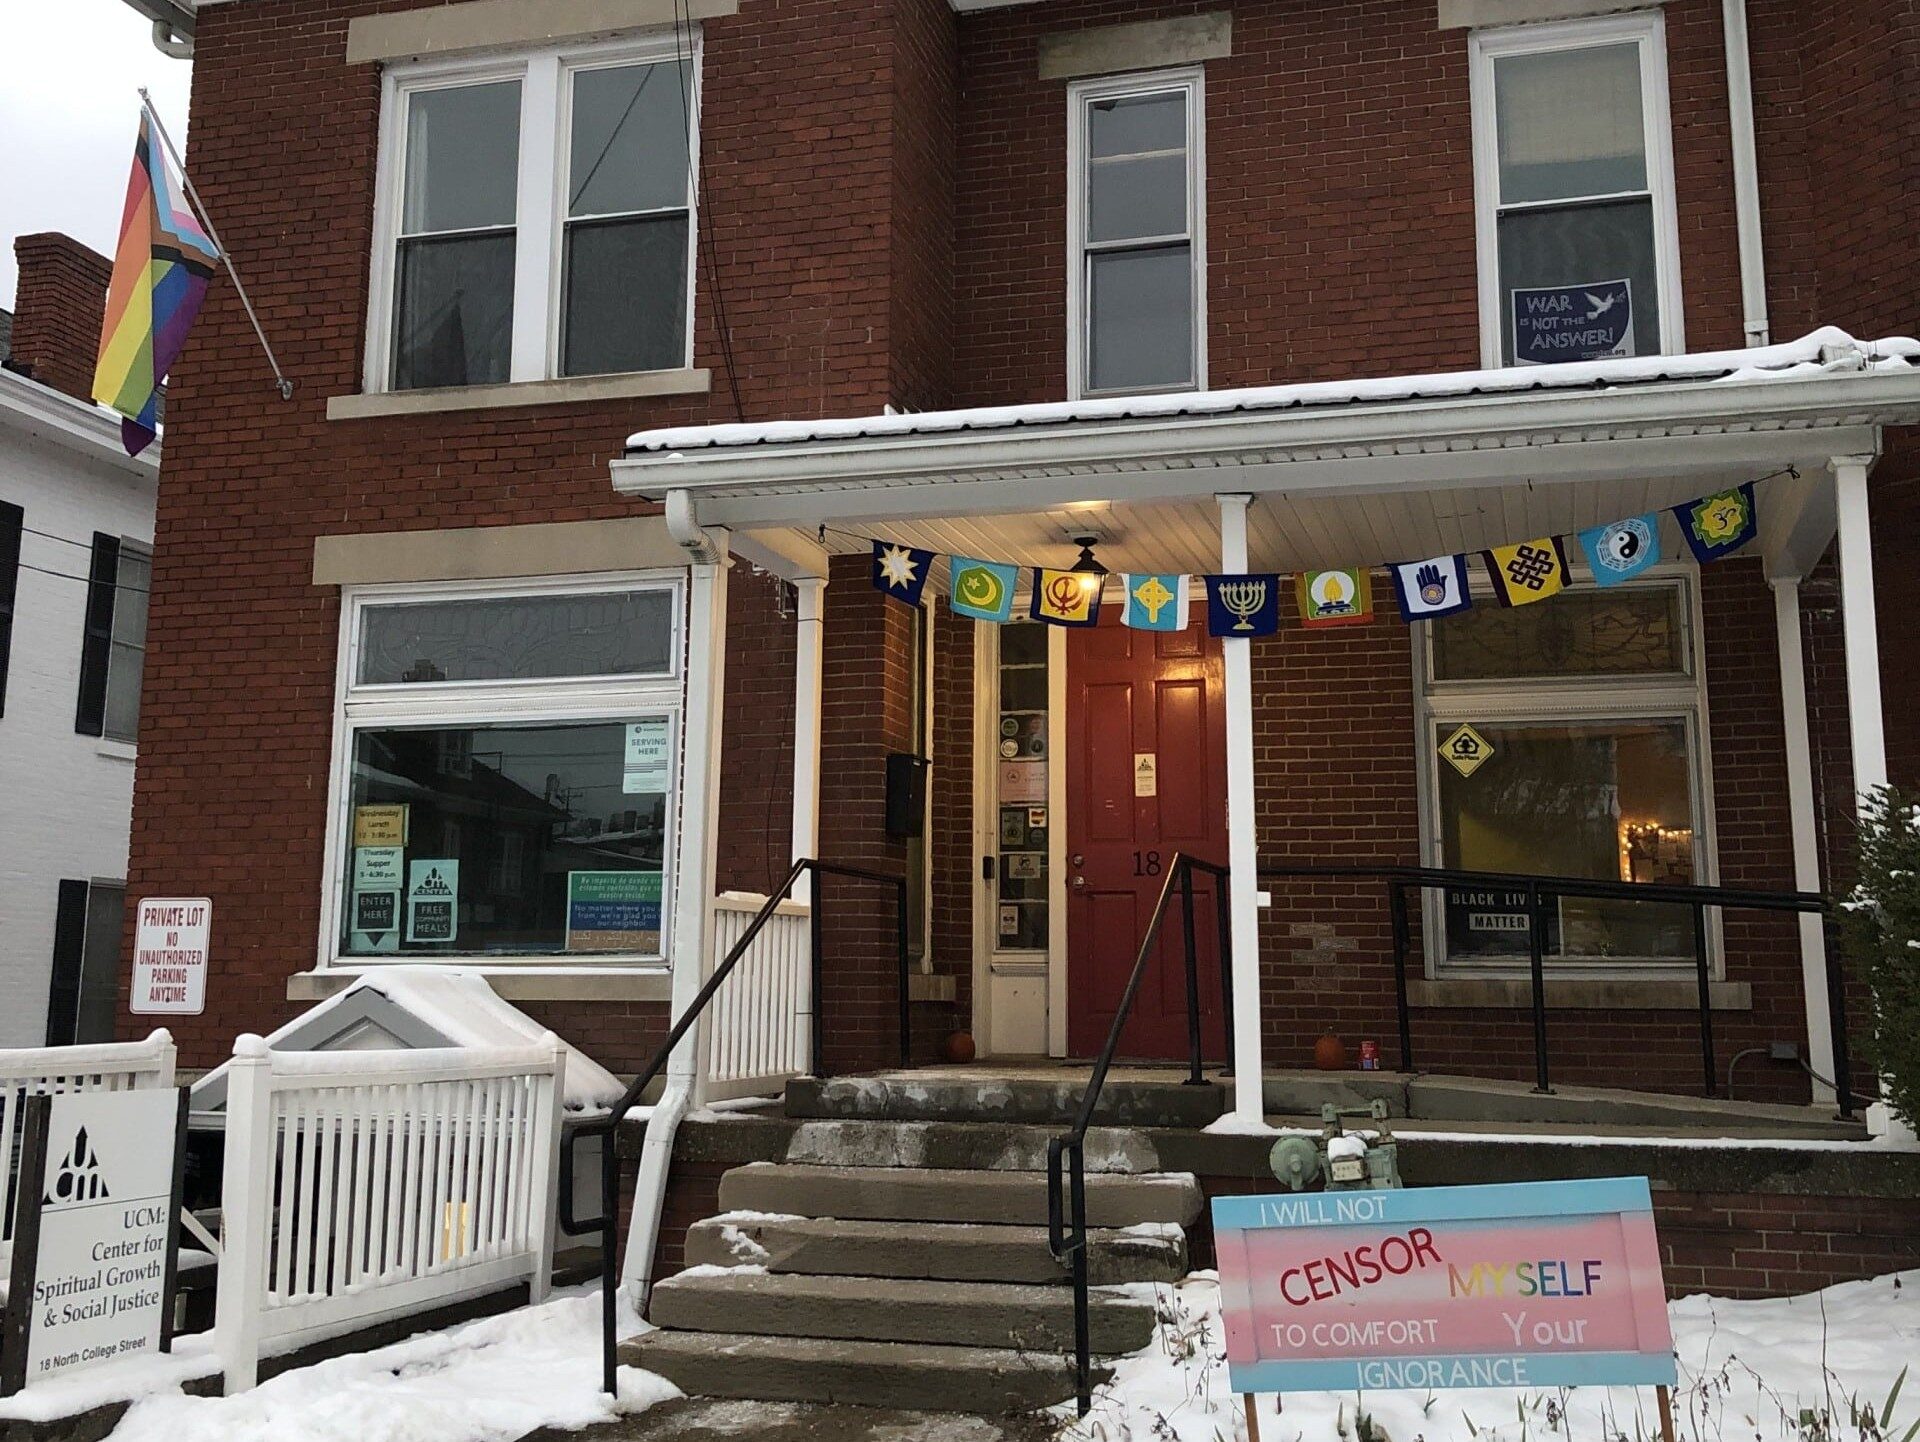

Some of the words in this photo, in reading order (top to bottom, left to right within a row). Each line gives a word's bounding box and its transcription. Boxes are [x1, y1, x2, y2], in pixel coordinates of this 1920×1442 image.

[1526, 295, 1573, 313] WAR
[1520, 318, 1529, 326] IS
[1532, 316, 1560, 331] NOT
[1562, 316, 1585, 326] THE
[1529, 327, 1614, 350] ANSWER!
[631, 738, 667, 746] SERVING
[638, 747, 659, 755] HERE
[364, 849, 395, 857] Thursday
[366, 860, 391, 868] Supper
[1133, 850, 1161, 876] 18
[360, 896, 391, 906] ENTER
[1452, 893, 1495, 906] BLACK
[143, 907, 184, 927] PRIVATE
[186, 907, 205, 927] LOT
[363, 909, 389, 919] HERE
[421, 905, 445, 915] FREE
[416, 923, 448, 933] MEALS
[1474, 915, 1526, 928] MATTER
[166, 932, 178, 947] NO
[139, 949, 203, 965] UNAUTHORIZED
[151, 968, 188, 984] PARKING
[149, 986, 187, 1002] ANYTIME
[124, 1206, 166, 1229] UCM:
[1260, 1202, 1267, 1226] I
[1271, 1200, 1332, 1226] WILL
[1336, 1195, 1387, 1222] NOT
[92, 1240, 141, 1261] Center
[143, 1233, 164, 1253] for
[1280, 1227, 1442, 1306] CENSOR
[1448, 1260, 1602, 1297] MYSELF
[34, 1270, 102, 1306] Spiritual
[105, 1260, 161, 1287] Growth
[43, 1308, 58, 1328] &
[62, 1296, 107, 1324] Social
[109, 1289, 160, 1319] Justice
[1270, 1323, 1306, 1348] TO
[1312, 1319, 1438, 1347] COMFORT
[1502, 1311, 1588, 1346] Your
[40, 1358, 51, 1372] 18
[53, 1353, 80, 1368] North
[81, 1344, 117, 1362] College
[119, 1336, 146, 1352] Street
[1356, 1357, 1531, 1389] IGNORANCE
